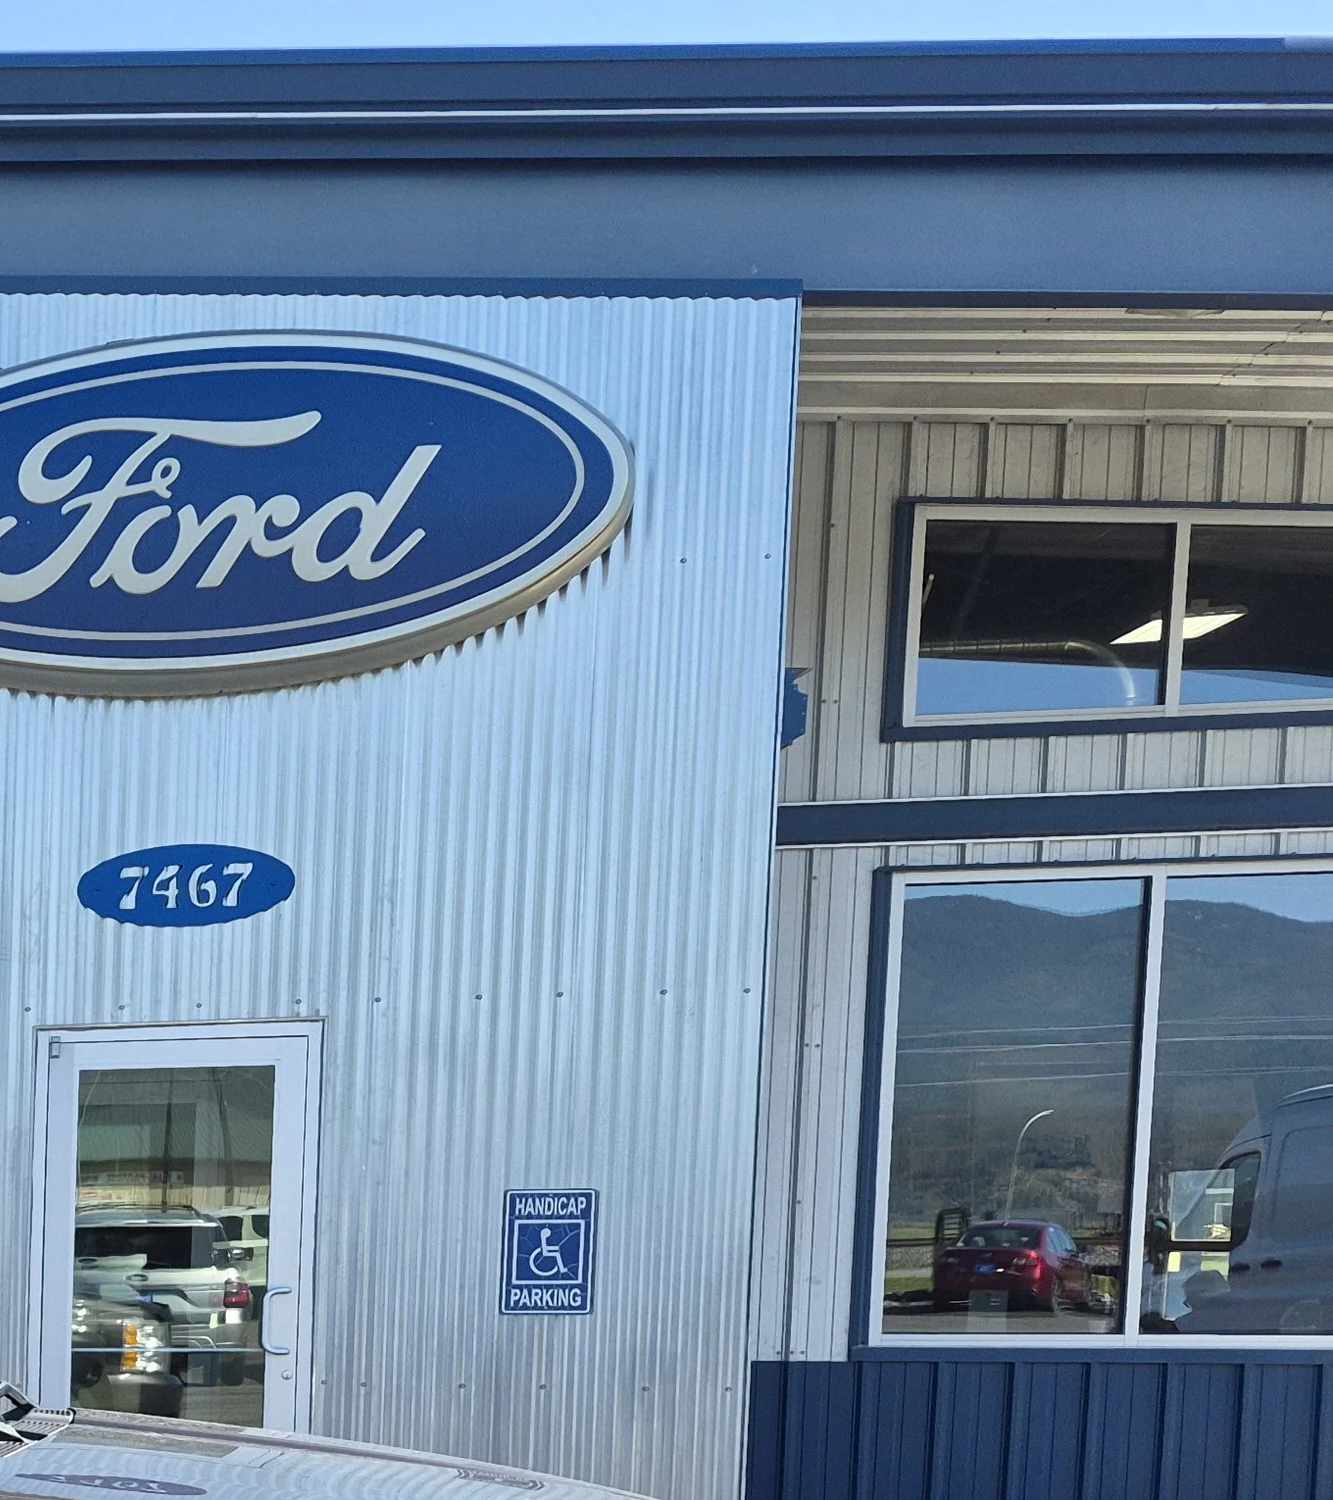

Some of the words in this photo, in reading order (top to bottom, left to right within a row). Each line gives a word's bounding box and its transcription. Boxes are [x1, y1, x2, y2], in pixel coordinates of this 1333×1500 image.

[119, 862, 254, 910] 7467
[515, 1196, 587, 1216] HANDICAP
[510, 1287, 582, 1307] PARKING
